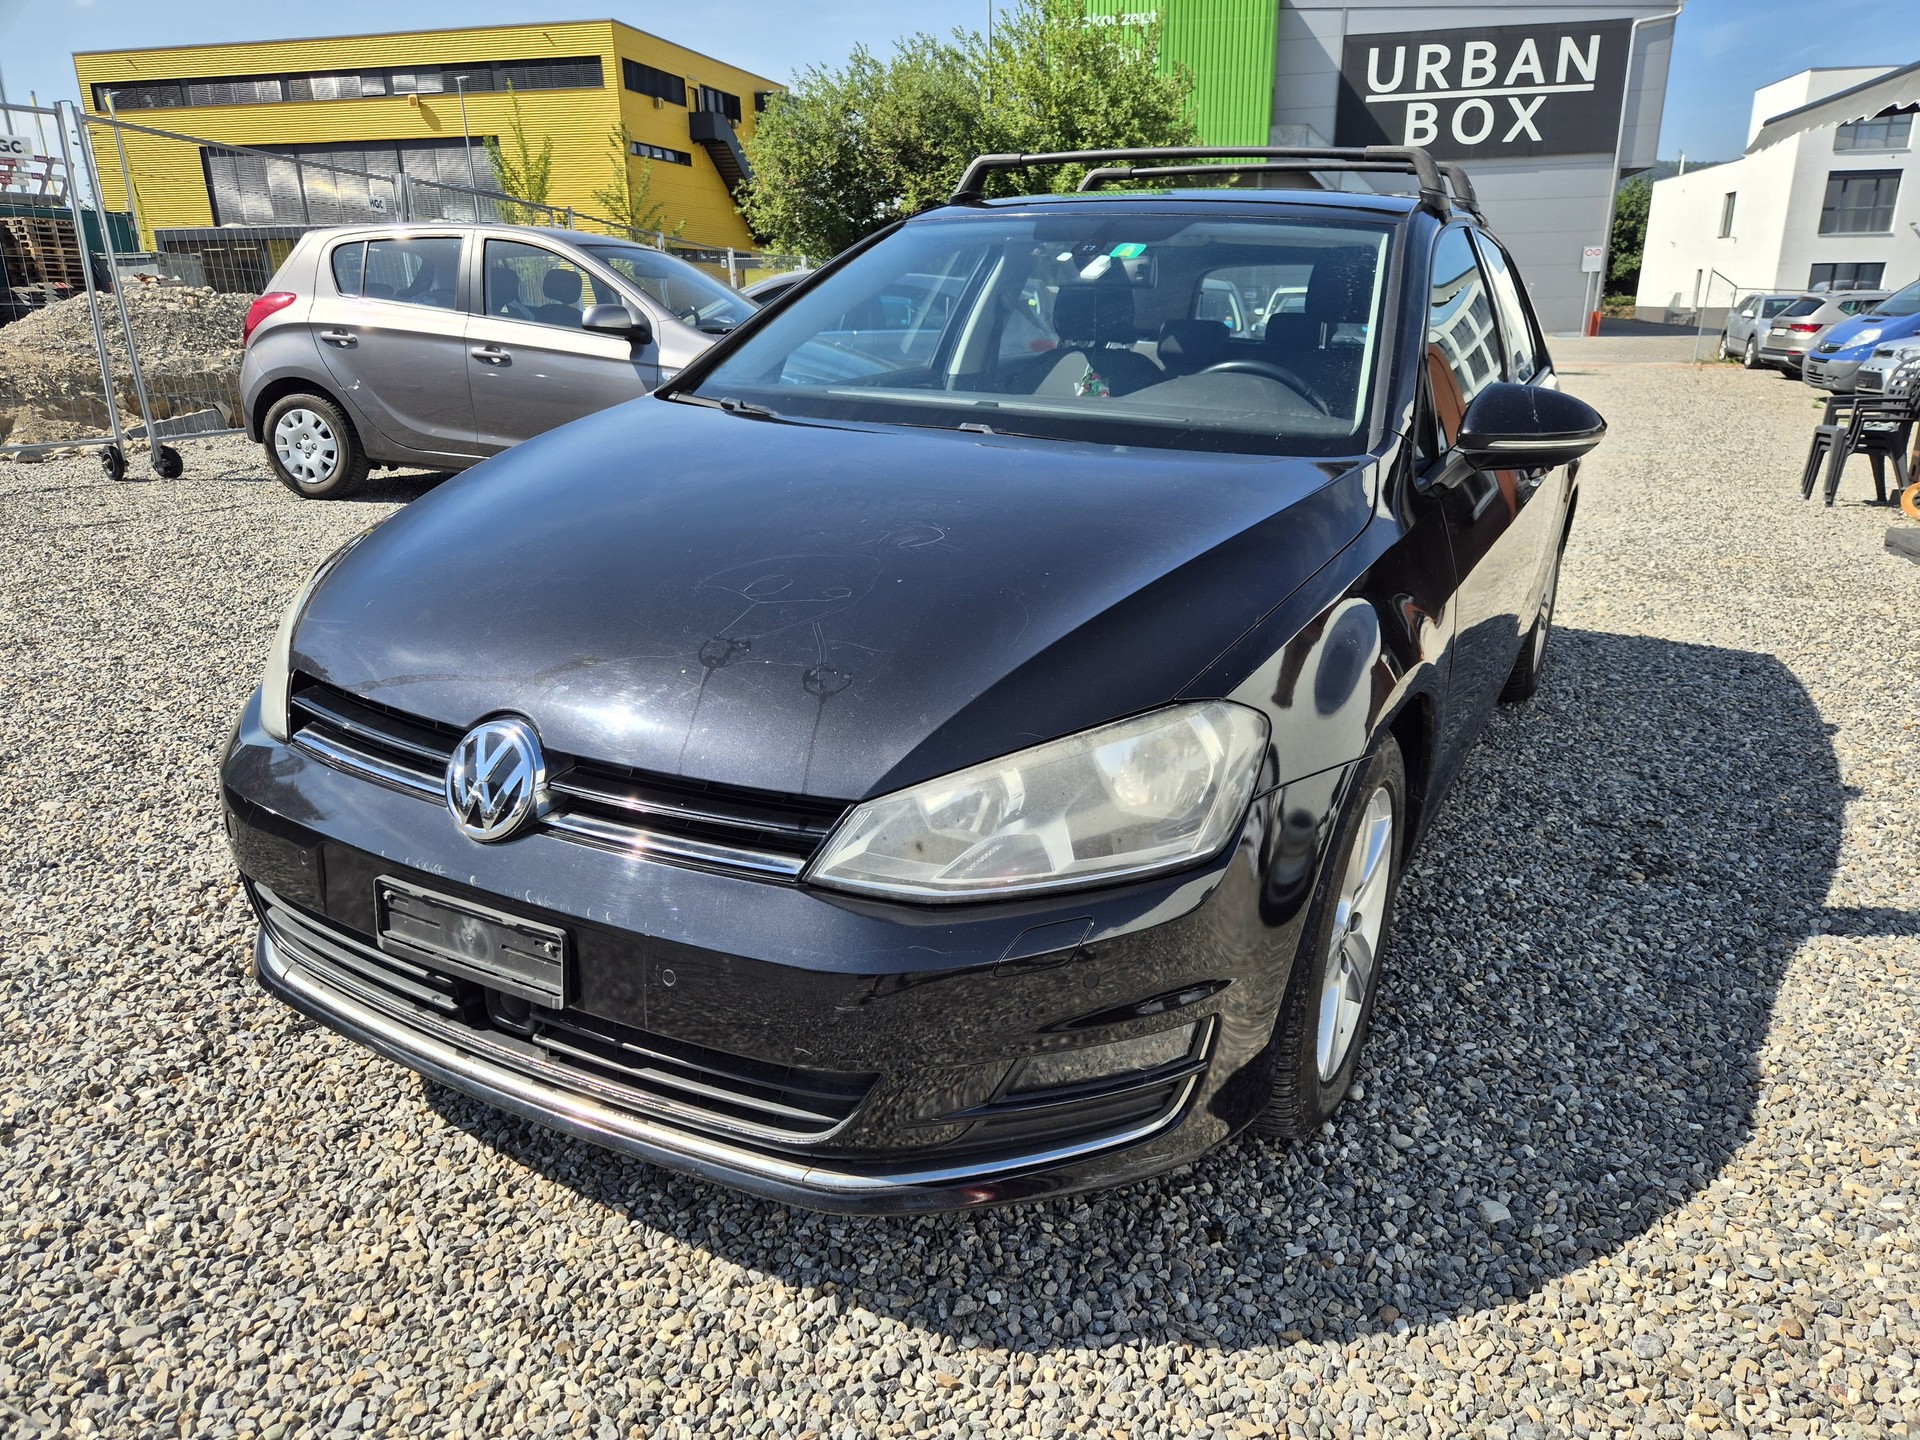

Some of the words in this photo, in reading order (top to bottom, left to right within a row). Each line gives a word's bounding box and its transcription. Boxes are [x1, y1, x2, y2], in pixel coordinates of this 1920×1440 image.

[1366, 34, 1601, 93] URBAN
[1403, 95, 1547, 147] BOX
[370, 199, 383, 209] HGC
